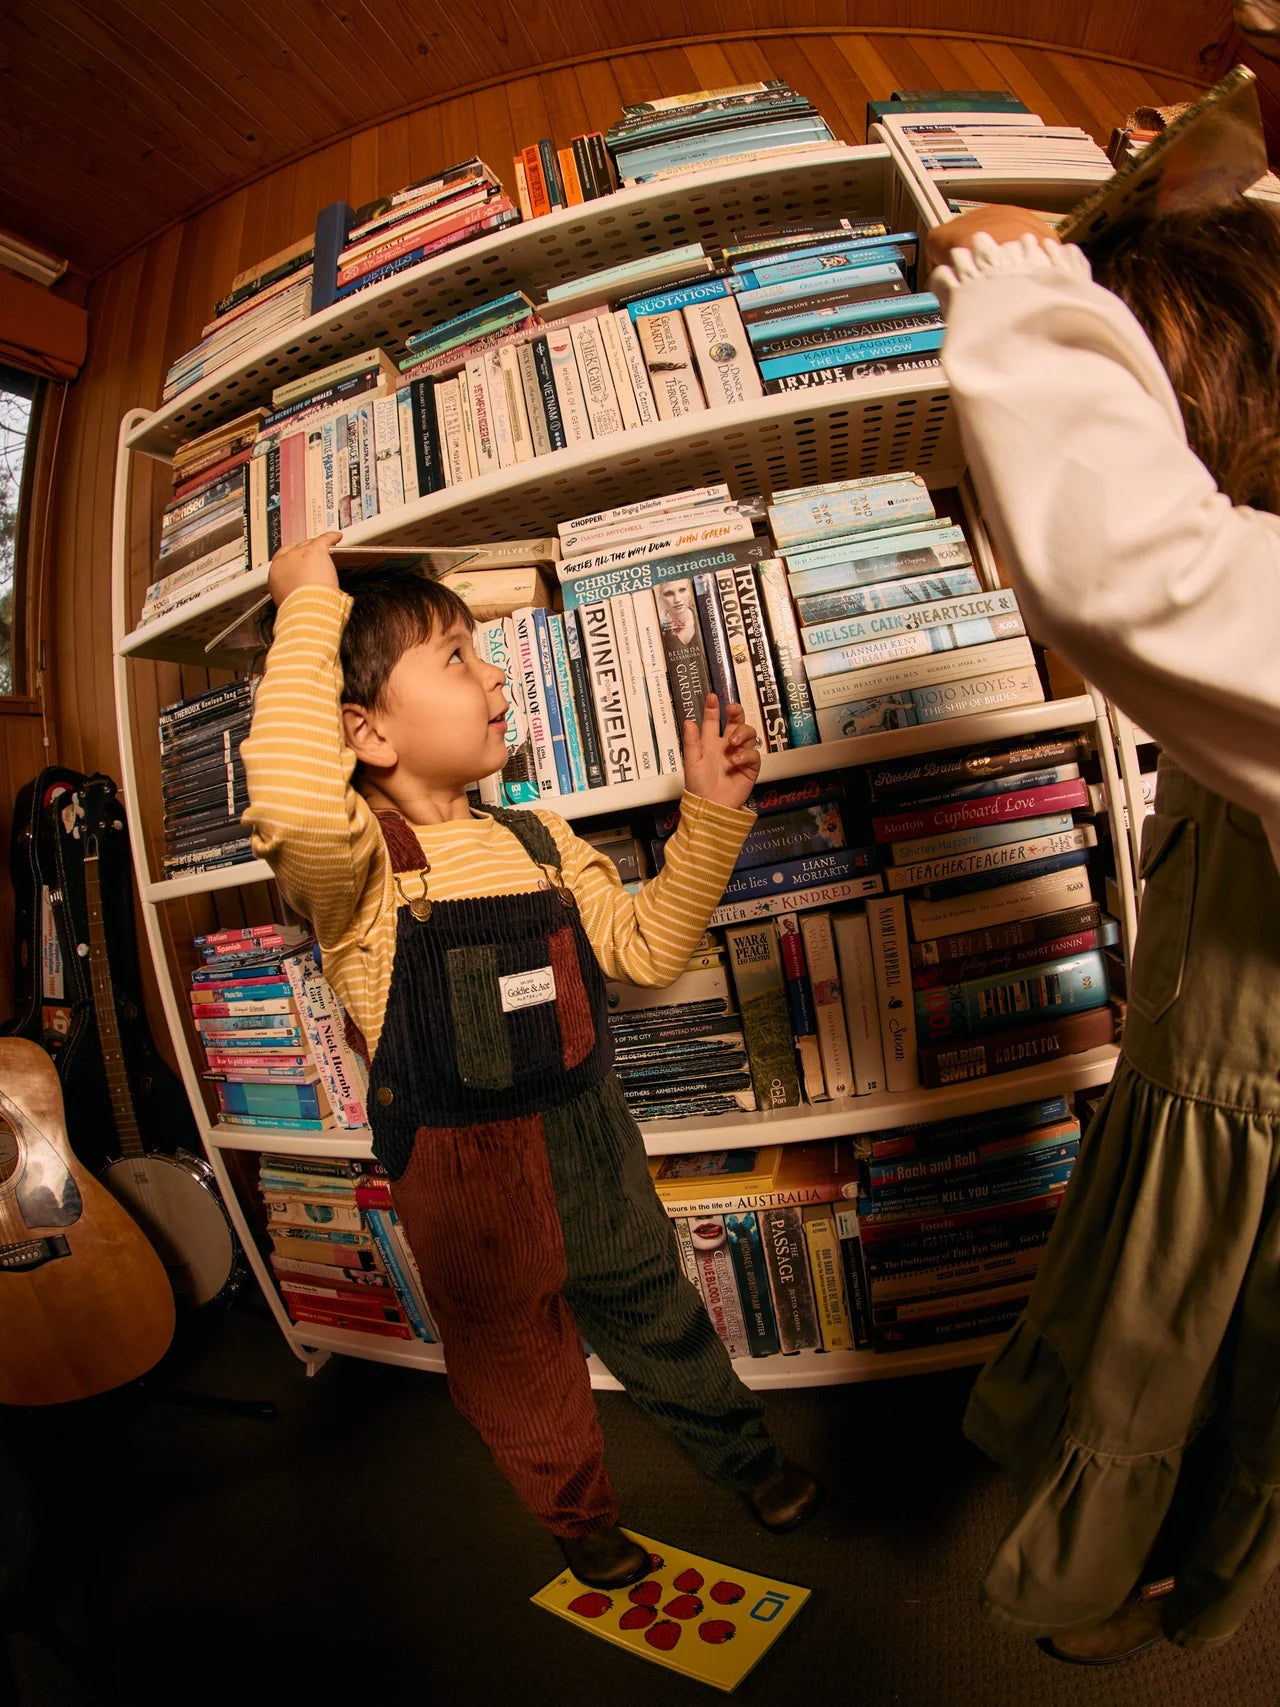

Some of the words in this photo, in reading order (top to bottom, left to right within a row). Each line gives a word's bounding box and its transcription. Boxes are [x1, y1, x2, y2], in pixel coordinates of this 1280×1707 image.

[362, 253, 412, 283] DETAILS
[634, 283, 724, 315] QUOTATIONS
[764, 306, 786, 315] WOMEN
[794, 302, 808, 310] LOVE
[648, 317, 667, 355] MARTIN
[699, 306, 718, 343] MARTIN
[852, 316, 931, 337] SAUNDERS
[421, 352, 466, 372] OUTDOOR
[504, 324, 537, 341] JAMIE
[538, 317, 568, 332] DURIE
[521, 347, 530, 364] NICK
[804, 347, 841, 360] KARIN
[844, 335, 913, 352] SLAUGHTER
[809, 357, 832, 367] THE
[836, 351, 866, 362] LAST
[870, 343, 913, 355] WIDOW
[272, 406, 293, 420] SECRET
[291, 402, 303, 412] LIFE
[301, 398, 311, 407] OF
[310, 389, 334, 403] WHALES
[542, 381, 558, 420] VIETNAM
[639, 392, 652, 423] Century
[360, 438, 369, 464] LAURA
[362, 465, 371, 490] FRIDAY
[570, 515, 603, 529] CHOPPER
[580, 530, 605, 543] DAVID
[606, 523, 644, 537] MITCHELL
[498, 547, 530, 555] SILVEY
[563, 556, 592, 574] TURTLES
[610, 551, 625, 562] THE
[628, 545, 646, 559] WAY
[648, 540, 672, 553] DOWN
[701, 526, 731, 539] GREEN
[573, 563, 651, 593] CHRISTOS
[656, 551, 736, 579] barracuda
[575, 577, 653, 604] TSIOLKAS
[719, 578, 744, 638] BLOCK
[516, 617, 529, 640] NOT
[808, 624, 865, 647] CHELSEA
[870, 616, 904, 633] CAIN
[910, 599, 995, 626] HEARTSICK
[520, 641, 533, 669] THAT
[584, 601, 617, 686] IRVINE
[667, 646, 701, 658] BELINDA
[755, 637, 764, 659] STORK
[840, 644, 884, 660] HANNAH
[886, 636, 919, 651] KENT
[524, 670, 538, 701] KIND
[689, 661, 702, 695] WHITE
[822, 683, 851, 696] SEXUAL
[853, 677, 883, 690] HEALTH
[886, 674, 899, 683] FOR
[902, 670, 920, 680] MEN
[918, 688, 957, 706] JOJO
[961, 676, 1016, 697] MOYES
[530, 701, 539, 715] OF
[785, 681, 803, 728] OWENS
[796, 682, 812, 720] DELIA
[922, 704, 943, 718] THE
[945, 700, 968, 713] SHIP
[969, 696, 982, 708] OF
[984, 692, 1018, 706] BRIDES
[159, 714, 172, 726] PAUL
[174, 704, 200, 721] THEROUX
[531, 717, 544, 746] GIRL
[874, 770, 922, 787] Russell
[923, 760, 963, 778] Brand
[883, 819, 924, 835] Morton
[933, 803, 1000, 830] Cupboard
[1003, 795, 1036, 813] Love
[792, 865, 849, 884] MORIARTY
[801, 857, 836, 870] LIANE
[750, 876, 768, 888] lies
[781, 885, 851, 909] KINDRED
[879, 907, 896, 937] NAOMI
[207, 933, 227, 943] Italian
[217, 943, 242, 954] Spanish
[734, 935, 759, 949] WAR
[760, 933, 768, 942] &
[736, 944, 770, 960] PEACE
[883, 941, 901, 988] CAMPBELL
[638, 1032, 651, 1040] CITY
[888, 1019, 908, 1062] Swan
[322, 1026, 338, 1053] Nick
[331, 1054, 351, 1100] Hornby
[940, 1061, 988, 1084] SMITH
[771, 1097, 787, 1107] Pan
[897, 1166, 927, 1181] Rock
[930, 1160, 951, 1172] and
[954, 1152, 977, 1168] Roll
[667, 1205, 688, 1213] hours
[736, 1189, 823, 1209] AUSTRALIA
[969, 1185, 989, 1198] YOU
[920, 1219, 954, 1232] foods
[770, 1219, 794, 1284] PASSAGE
[789, 1242, 798, 1257] THE
[739, 1237, 753, 1269] MICHAEL
[754, 1312, 765, 1336] SHATTER
